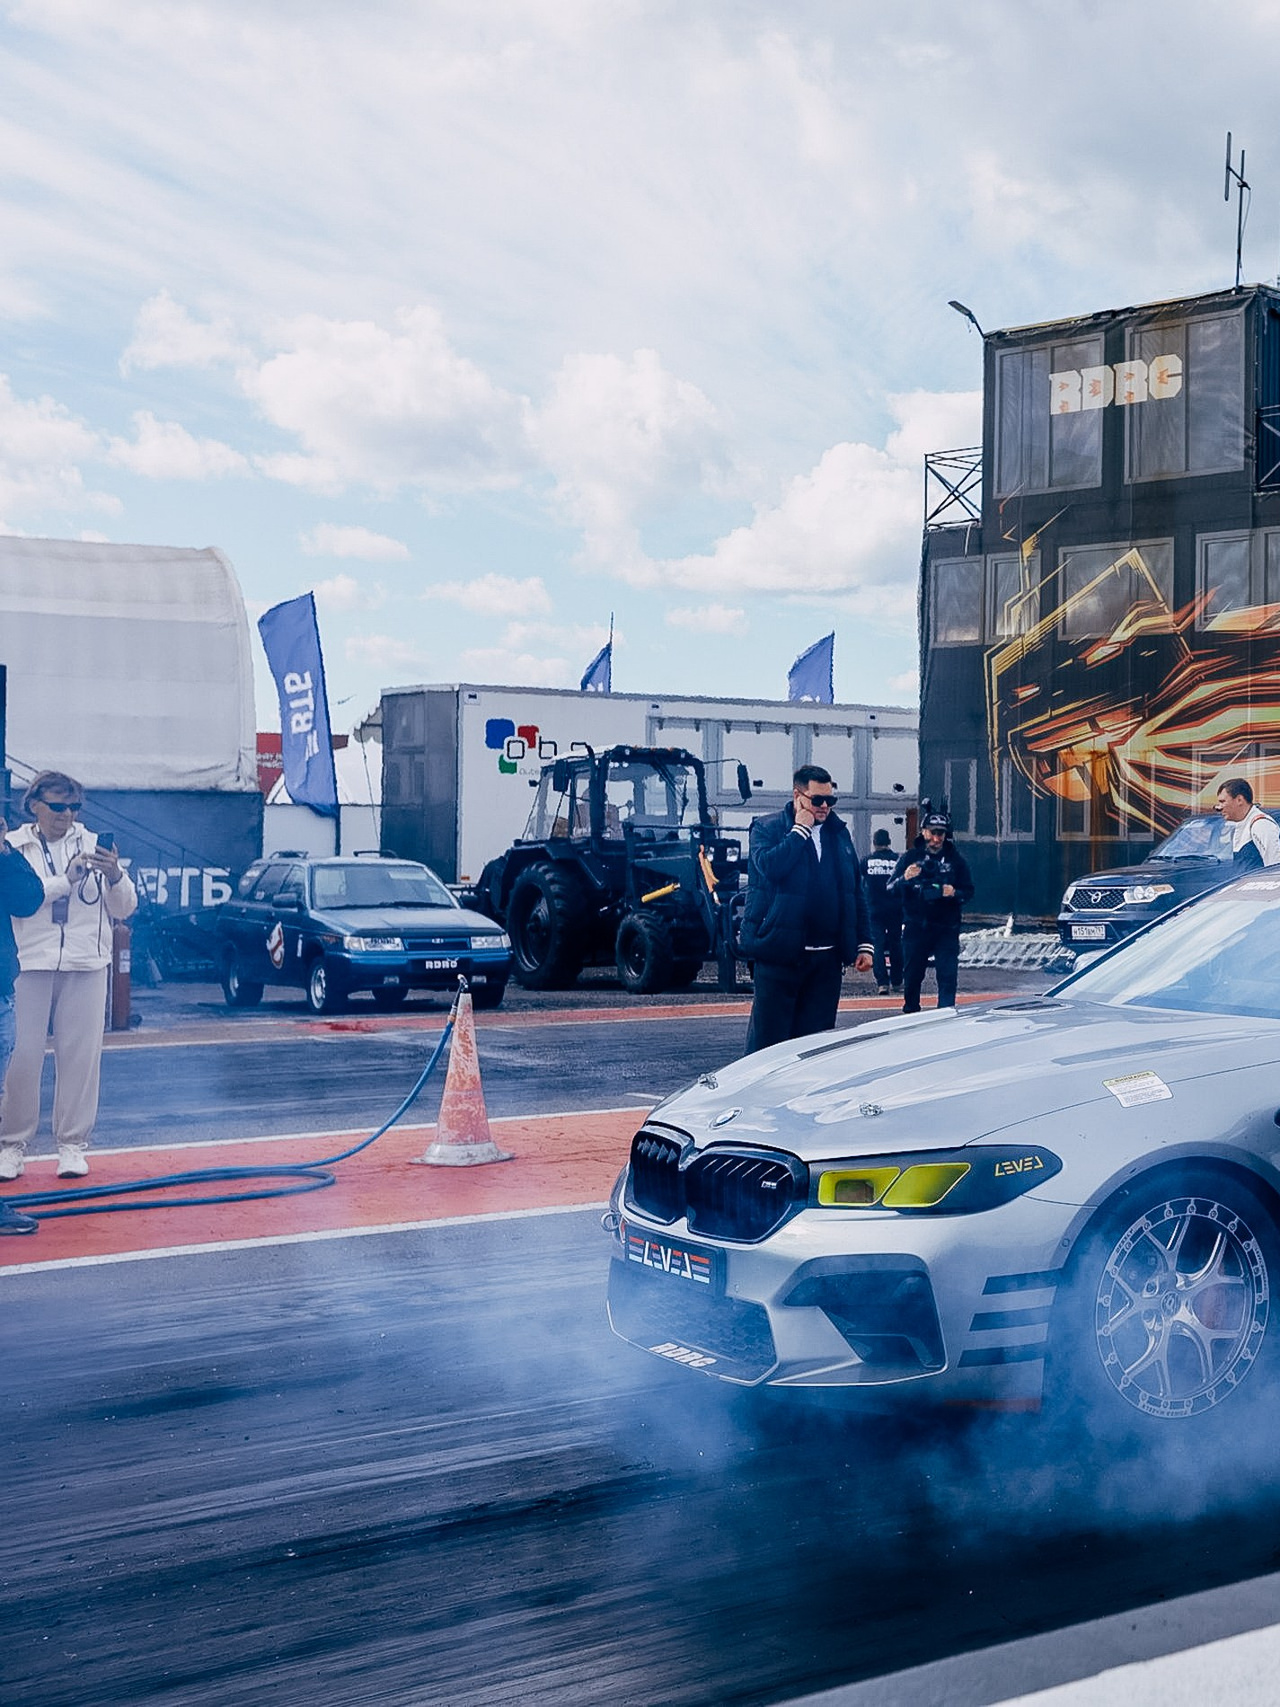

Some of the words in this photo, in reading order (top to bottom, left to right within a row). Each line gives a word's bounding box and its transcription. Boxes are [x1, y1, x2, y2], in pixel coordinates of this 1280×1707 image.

[1049, 353, 1183, 415] RDRC
[139, 867, 233, 907] ВТБ
[994, 1155, 1044, 1177] LEVEL
[650, 1342, 717, 1368] RDRC
